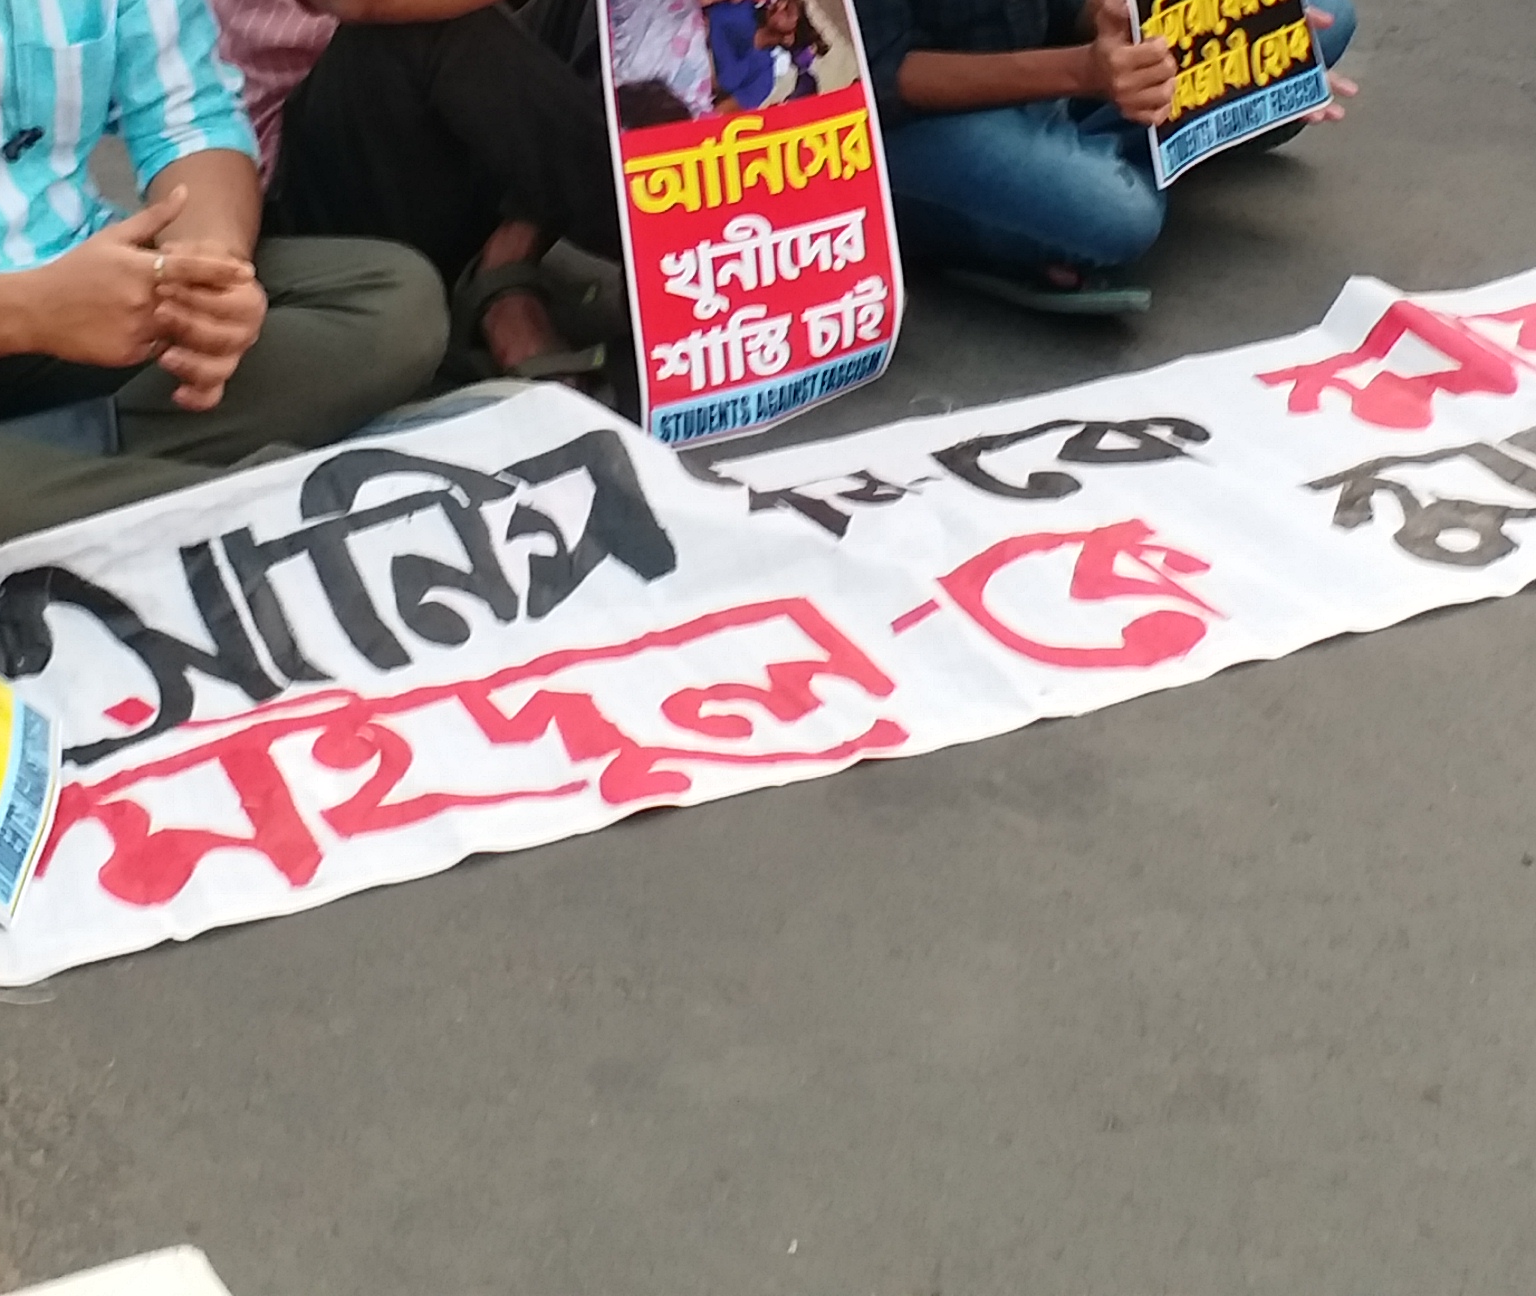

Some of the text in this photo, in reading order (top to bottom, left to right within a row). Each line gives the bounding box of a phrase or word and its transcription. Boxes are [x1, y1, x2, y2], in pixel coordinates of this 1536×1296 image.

[1251, 16, 1312, 87] হোক
[624, 108, 874, 215] আনিসের
[659, 208, 869, 321] খুনীদের
[651, 274, 889, 391] শাস্তি চাই
[658, 394, 753, 444] STUDENTS
